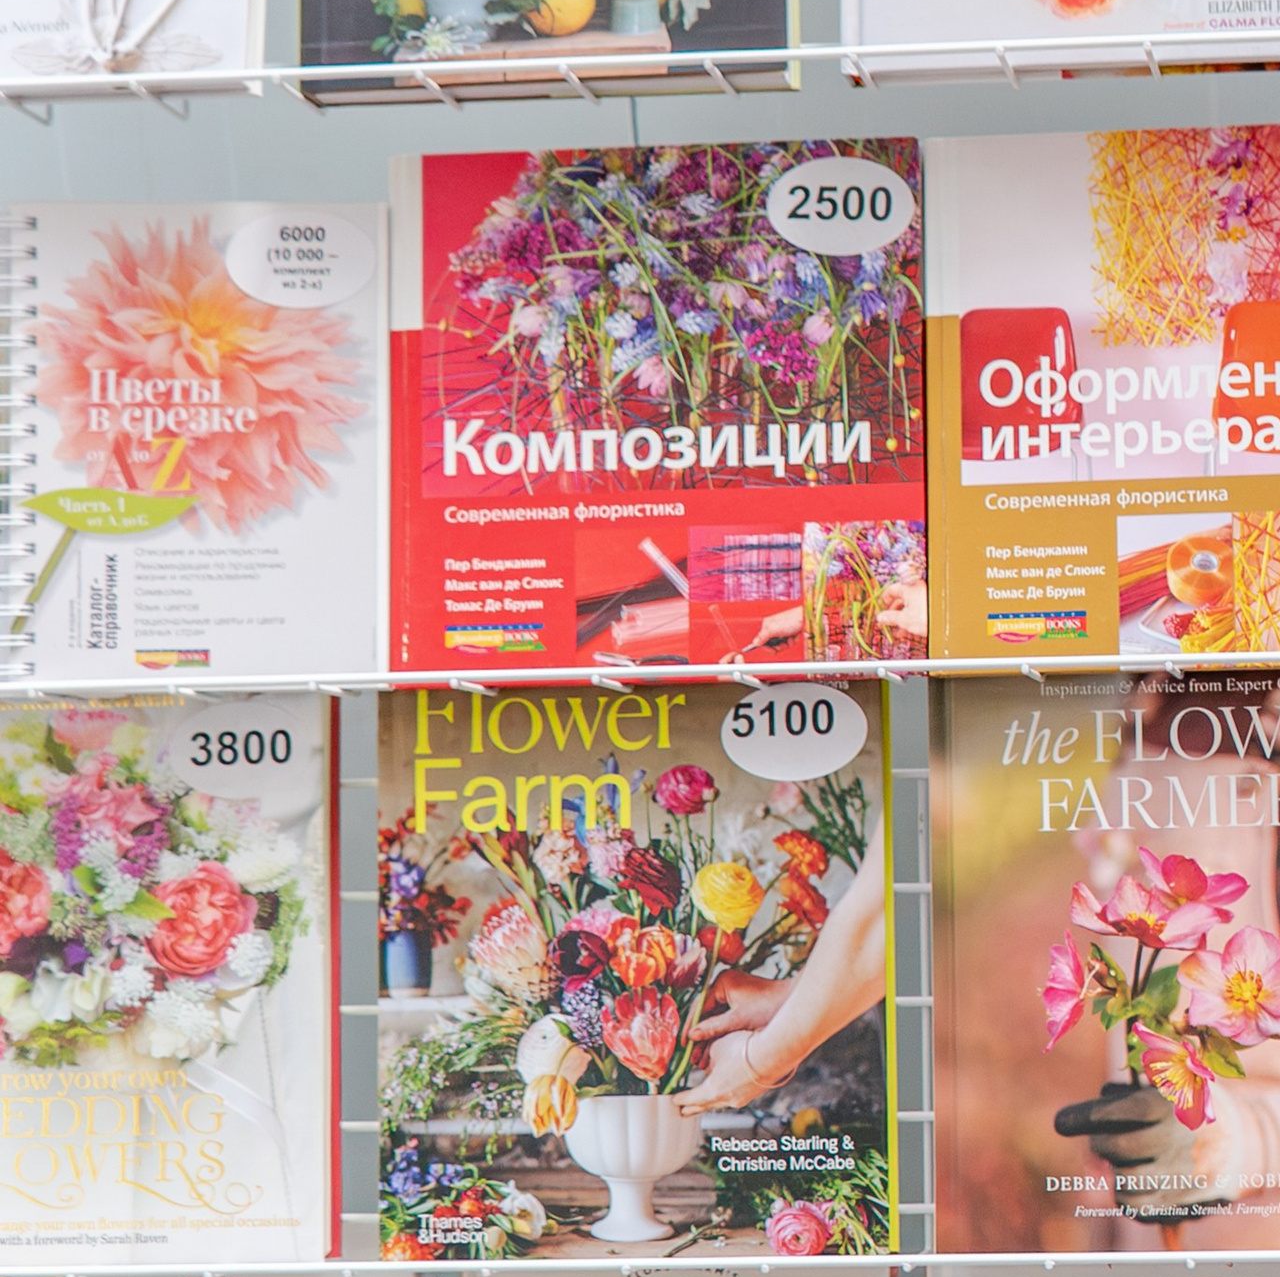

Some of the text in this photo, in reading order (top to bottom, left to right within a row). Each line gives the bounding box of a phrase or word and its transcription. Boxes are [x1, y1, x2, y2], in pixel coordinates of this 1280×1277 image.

[788, 186, 892, 221] 2500
[279, 227, 326, 242] 6000
[88, 368, 222, 406] Цветы
[88, 403, 258, 436] в срезке
[444, 419, 871, 479] Композиции
[445, 501, 684, 524] Современная флористика
[417, 691, 684, 754] Flower
[731, 700, 835, 738] 5100
[190, 732, 291, 765] 3800
[1001, 712, 1078, 766] the
[417, 761, 633, 835] Farm
